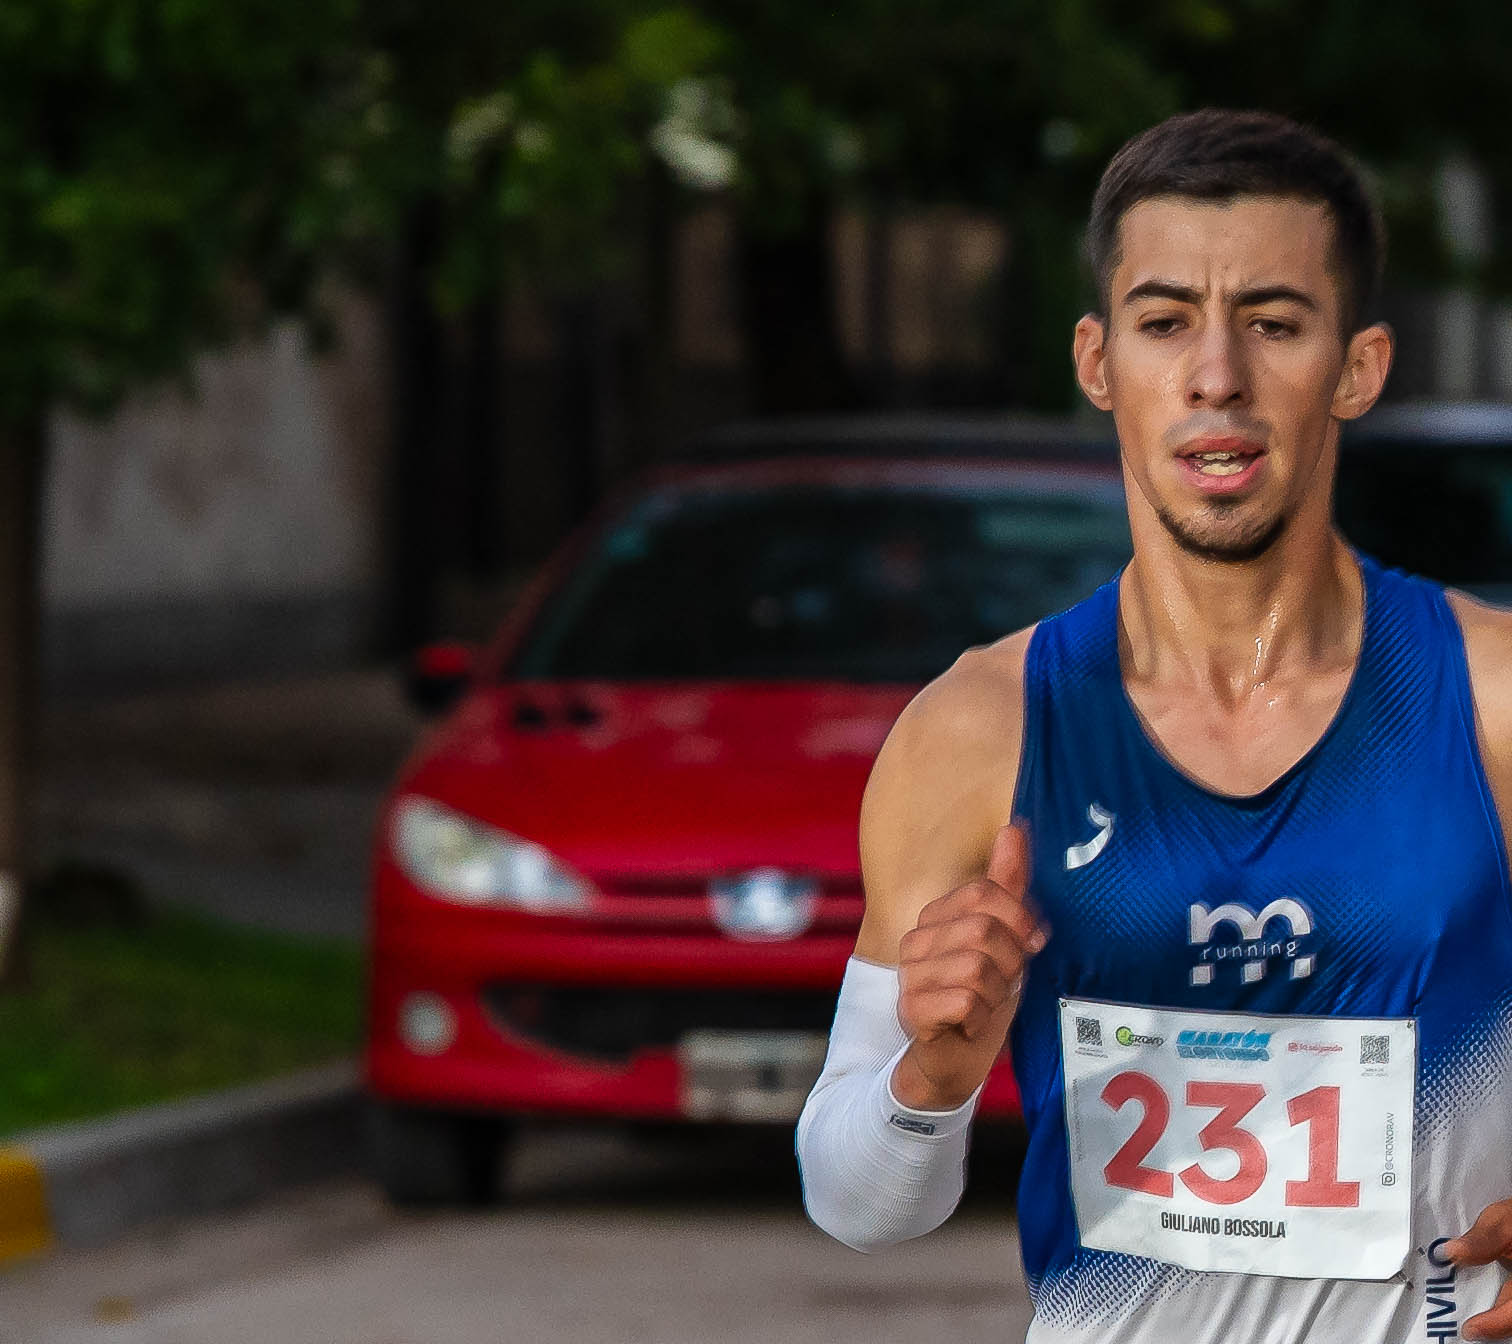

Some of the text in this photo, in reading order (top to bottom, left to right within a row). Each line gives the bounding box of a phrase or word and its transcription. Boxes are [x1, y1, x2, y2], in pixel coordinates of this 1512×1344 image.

[1202, 941, 1297, 960] running
[1100, 1071, 1360, 1207] 231
[1160, 1211, 1286, 1239] GIULIANO BOSSOLA
